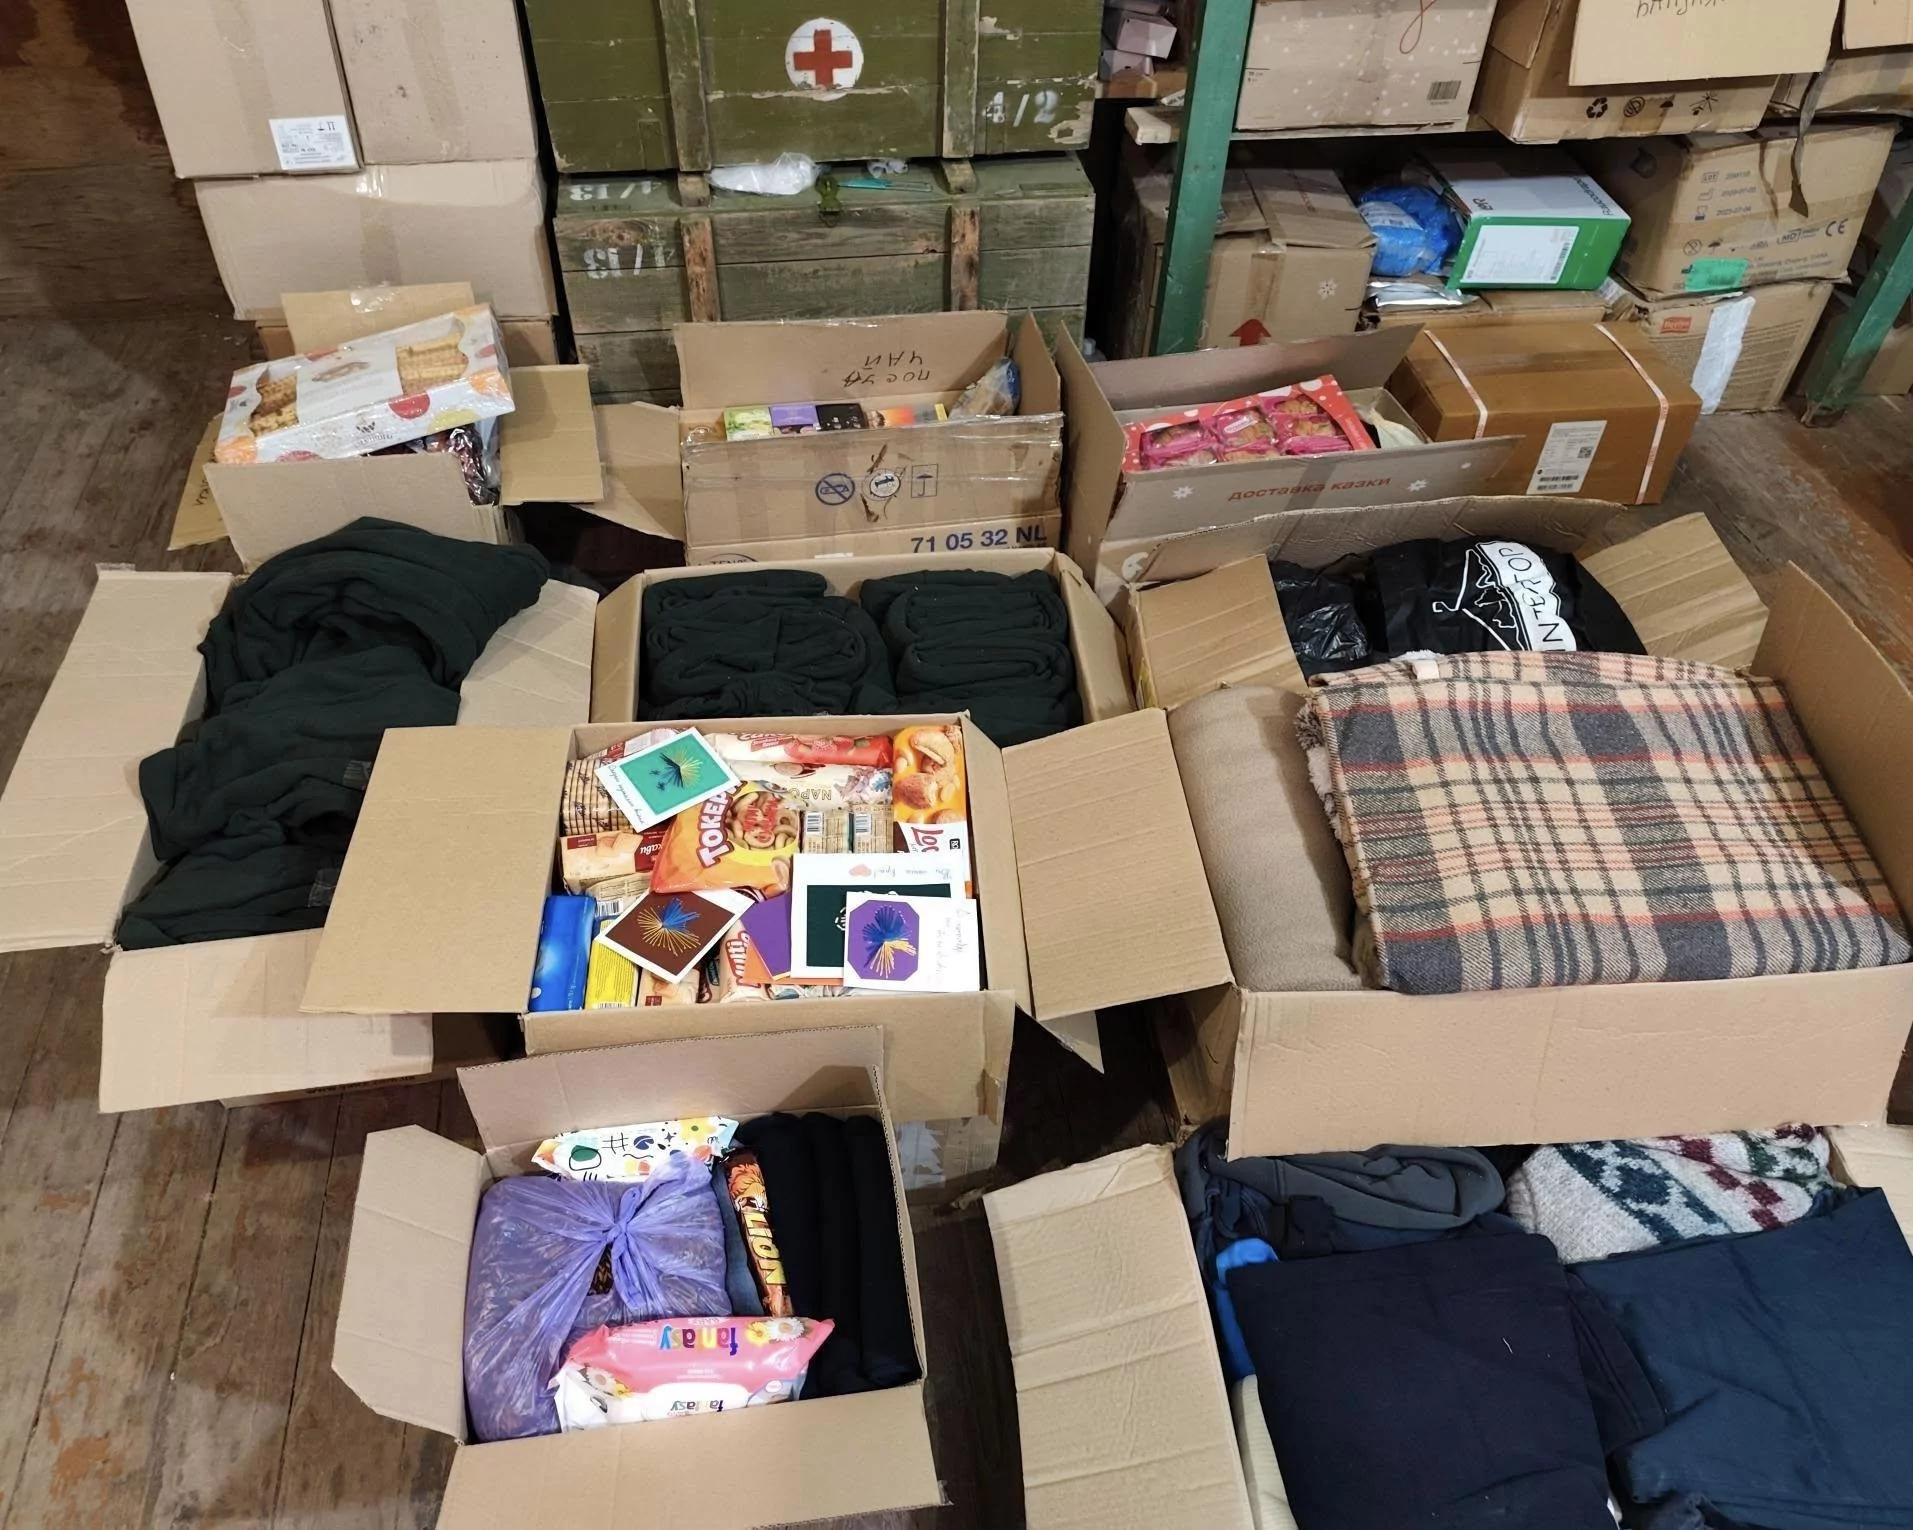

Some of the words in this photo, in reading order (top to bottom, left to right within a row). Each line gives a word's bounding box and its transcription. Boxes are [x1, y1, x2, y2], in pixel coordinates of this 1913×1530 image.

[982, 91, 1058, 128] 4/2
[863, 350, 924, 370] ЧАЙ
[1228, 482, 1326, 502] доставка
[1330, 476, 1392, 491] казки
[910, 536, 936, 554] 71
[945, 532, 973, 551] 05
[980, 529, 1009, 549] 32
[1015, 524, 1047, 545] NL
[743, 1212, 787, 1285] LION
[660, 1325, 739, 1357] fantasy
